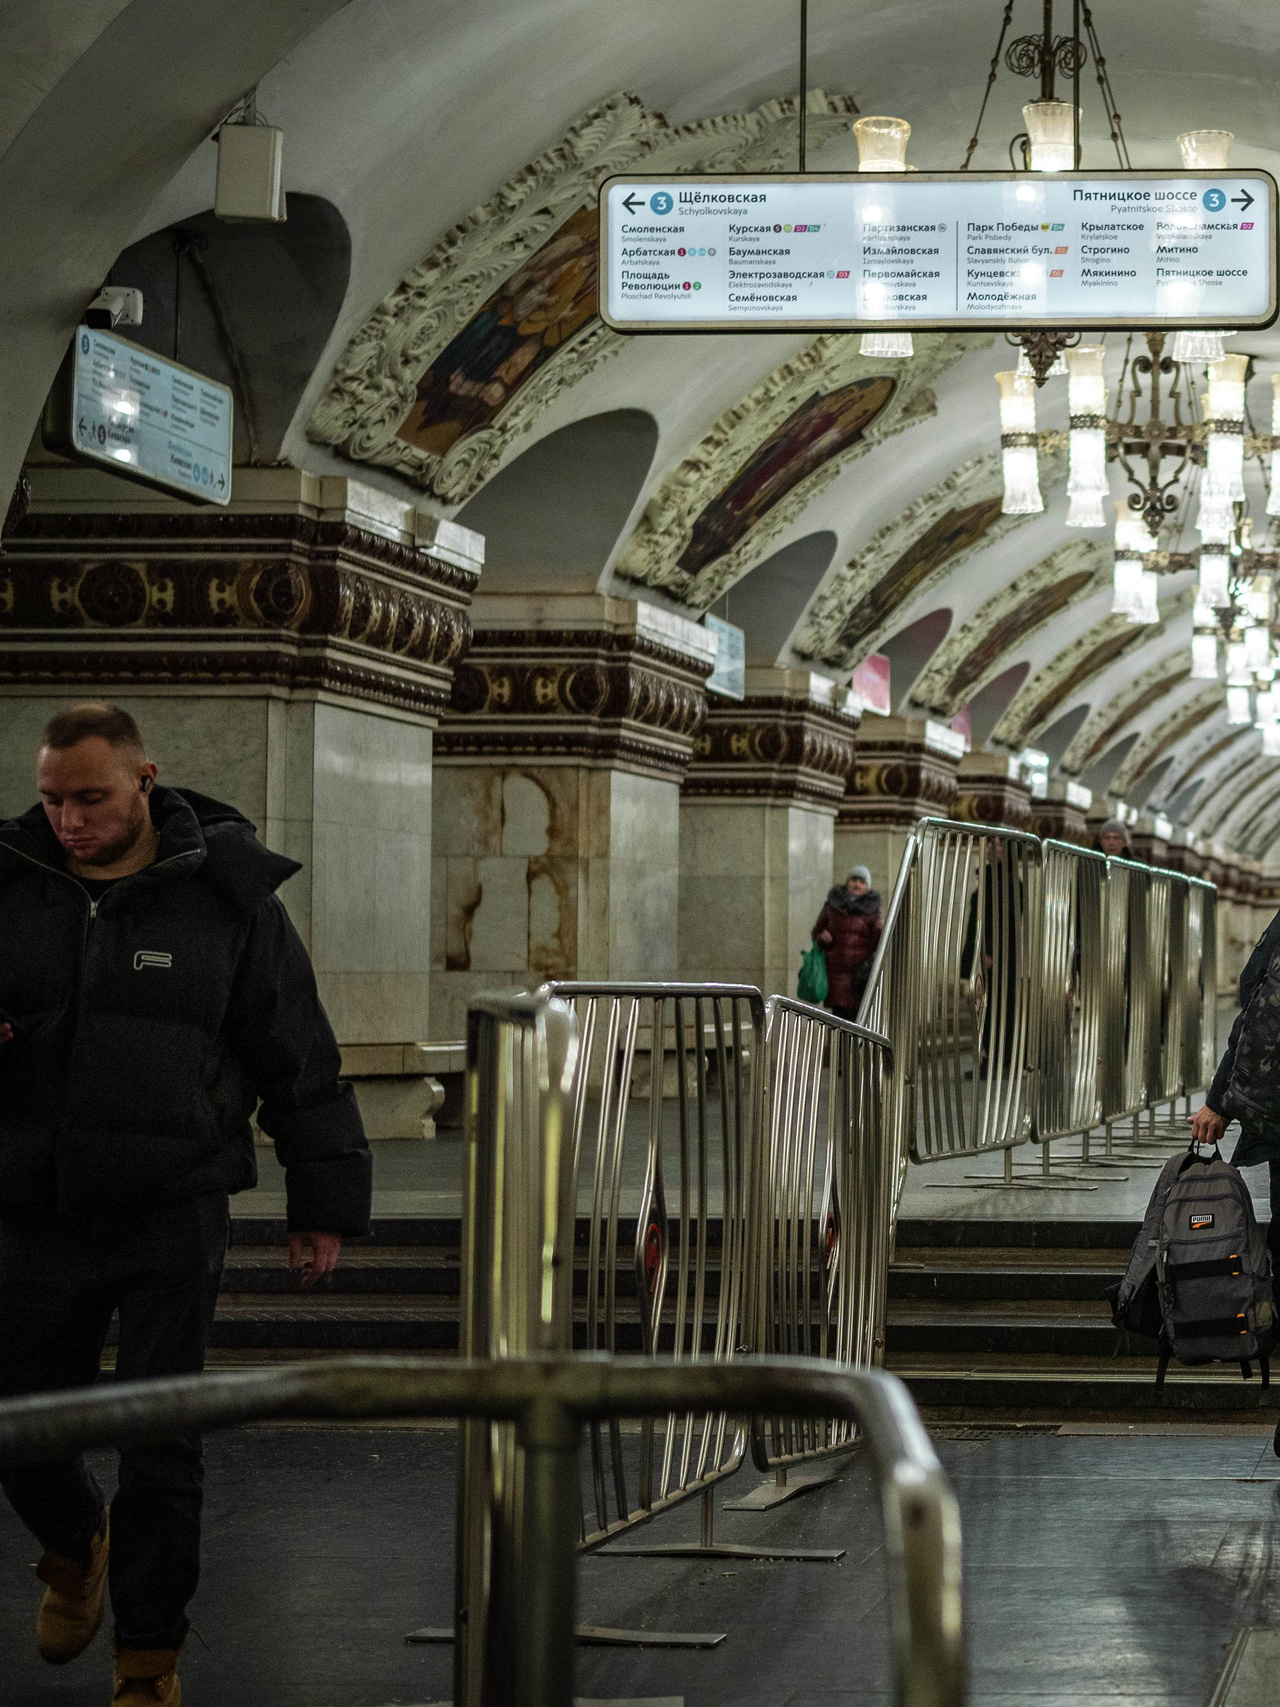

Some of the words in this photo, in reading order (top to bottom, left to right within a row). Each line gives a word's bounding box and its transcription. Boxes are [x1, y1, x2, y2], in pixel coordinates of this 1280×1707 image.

[656, 196, 667, 211] 3
[678, 191, 767, 206] Щёлковская
[1073, 189, 1151, 202] Пятницкое
[1154, 191, 1198, 201] шоссе
[1208, 193, 1220, 207] 3
[678, 206, 748, 216] Schyolkovskaya
[1110, 204, 1163, 214] Pyatnitskoe
[621, 224, 685, 233] Смоленская
[728, 223, 771, 234] Курская
[863, 223, 936, 233] Партизанская
[967, 222, 994, 233] Парк
[996, 222, 1039, 232] Победы
[1081, 222, 1144, 232] Крылатское
[621, 247, 676, 258] Арбатская
[728, 247, 791, 258] Бауманская
[863, 246, 939, 255] Измайловская
[967, 245, 1029, 255] Славянский
[1031, 245, 1053, 256] бул.
[1081, 245, 1130, 256] Строгино
[1156, 245, 1199, 254] Митино
[863, 257, 914, 265] Izmaylovskaya
[967, 257, 1006, 265] Slavyanskiy
[1081, 256, 1111, 264] Strogino
[621, 270, 670, 280] Площадь
[728, 270, 825, 280] Электрозаводская
[863, 269, 940, 279] Первомайская
[1081, 268, 1137, 277] Мякинино
[1156, 268, 1213, 277] Пятницкое
[1216, 269, 1248, 277] шоссе
[621, 282, 681, 291] Революции
[728, 281, 792, 289] Elektrozavodskaya
[621, 292, 652, 300] Ploschad
[654, 292, 692, 301] Revolyutsii
[728, 293, 798, 302] Семёновская
[967, 291, 1037, 301] Молодёжная
[728, 304, 783, 312] Semyonovskaya
